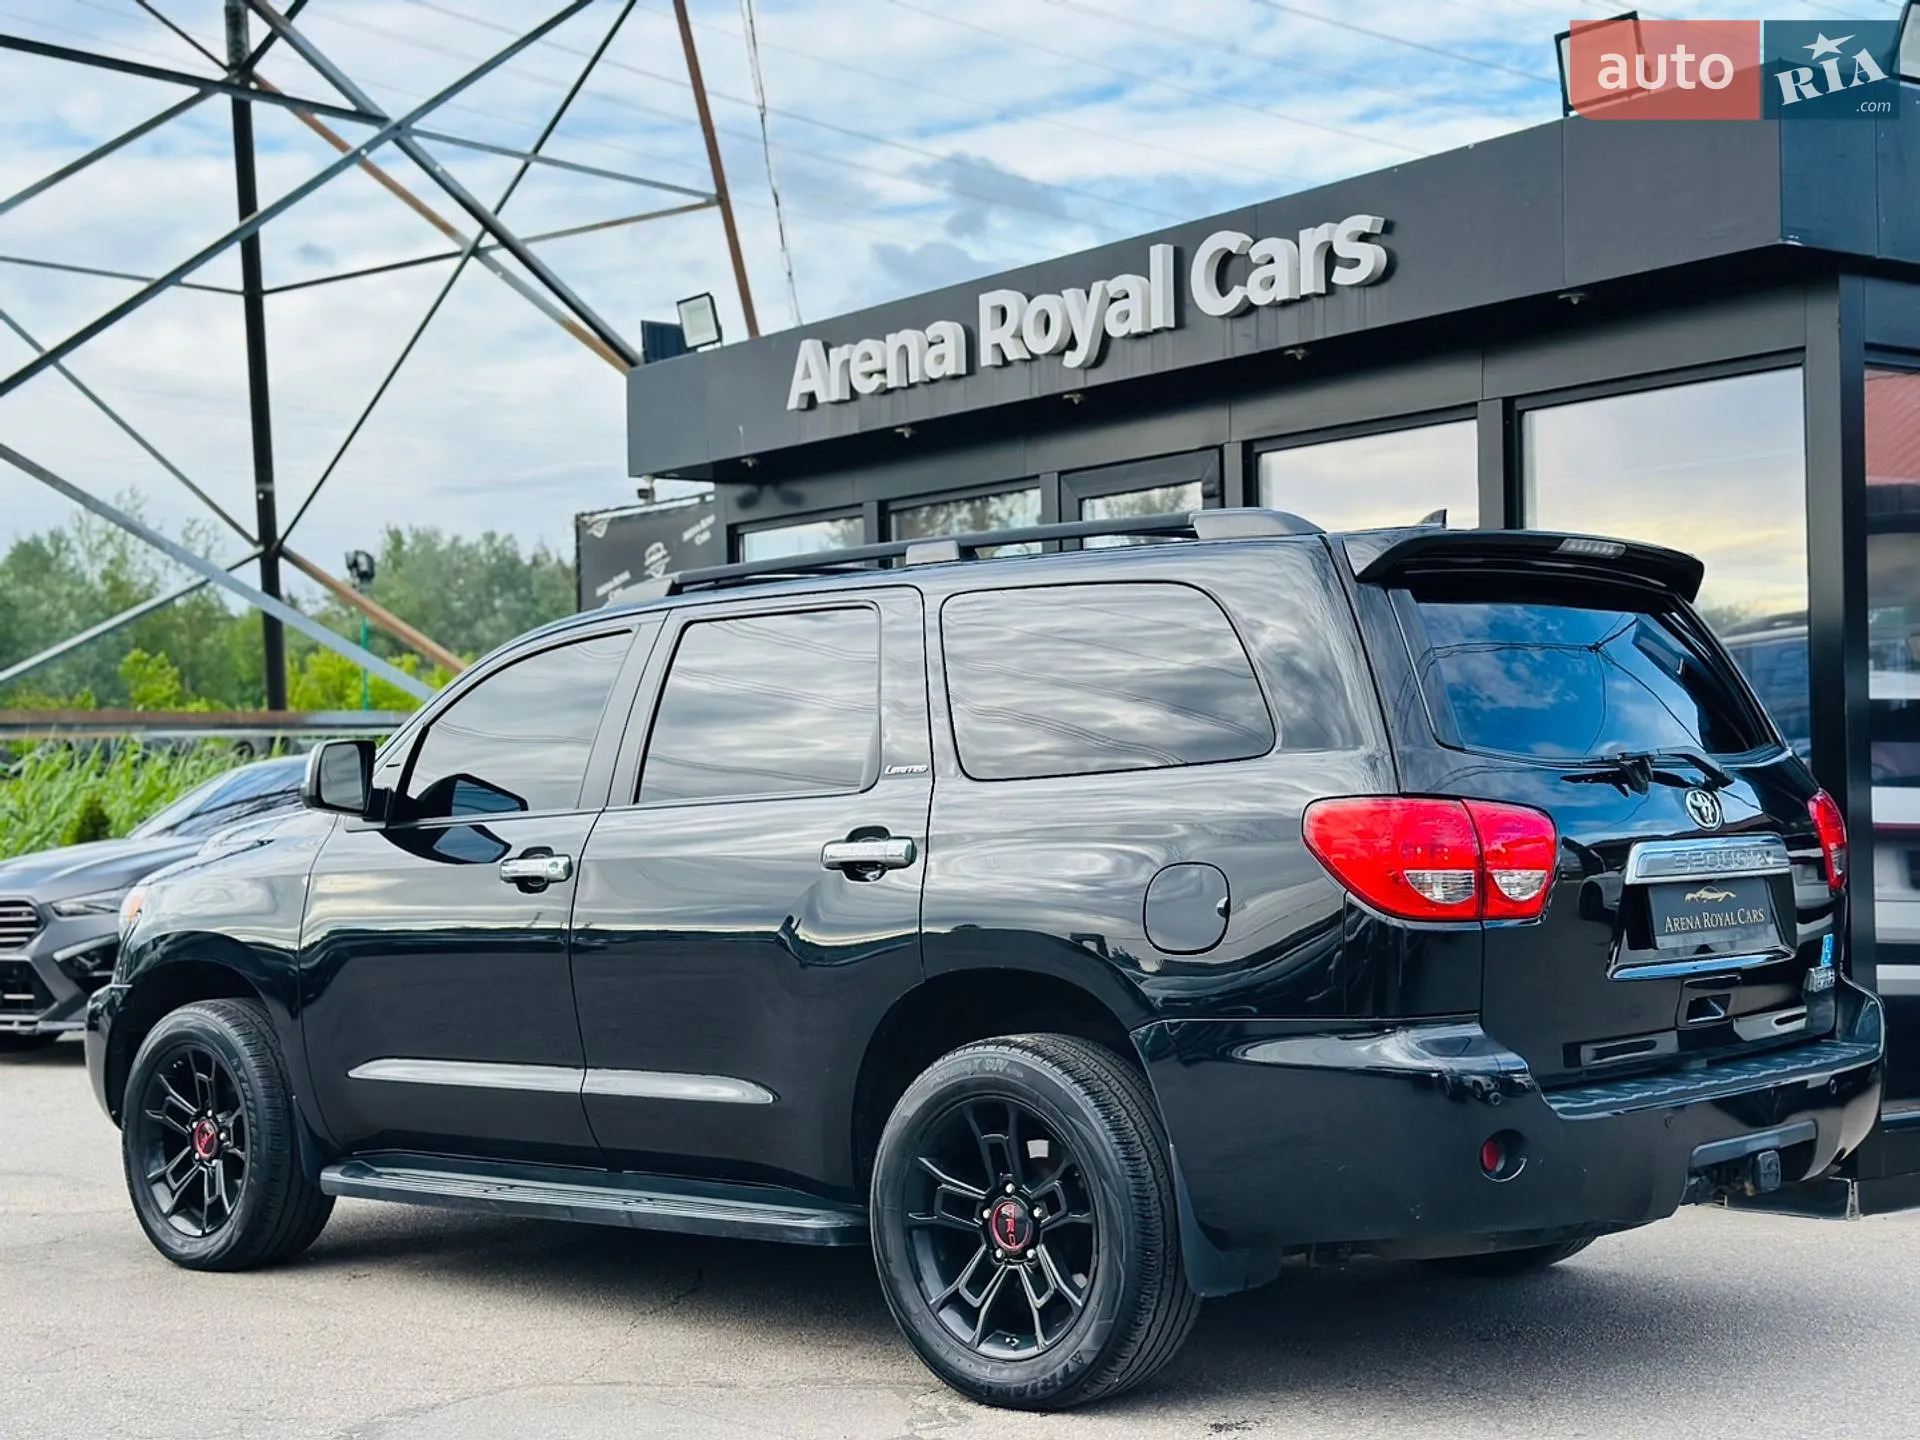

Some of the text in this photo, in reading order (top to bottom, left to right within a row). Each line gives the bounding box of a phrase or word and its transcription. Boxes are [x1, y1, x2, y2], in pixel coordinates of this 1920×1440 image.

[786, 213, 1389, 411] Arena Royal Cars
[1664, 907, 1766, 934] ARENA ROYAL CARS
